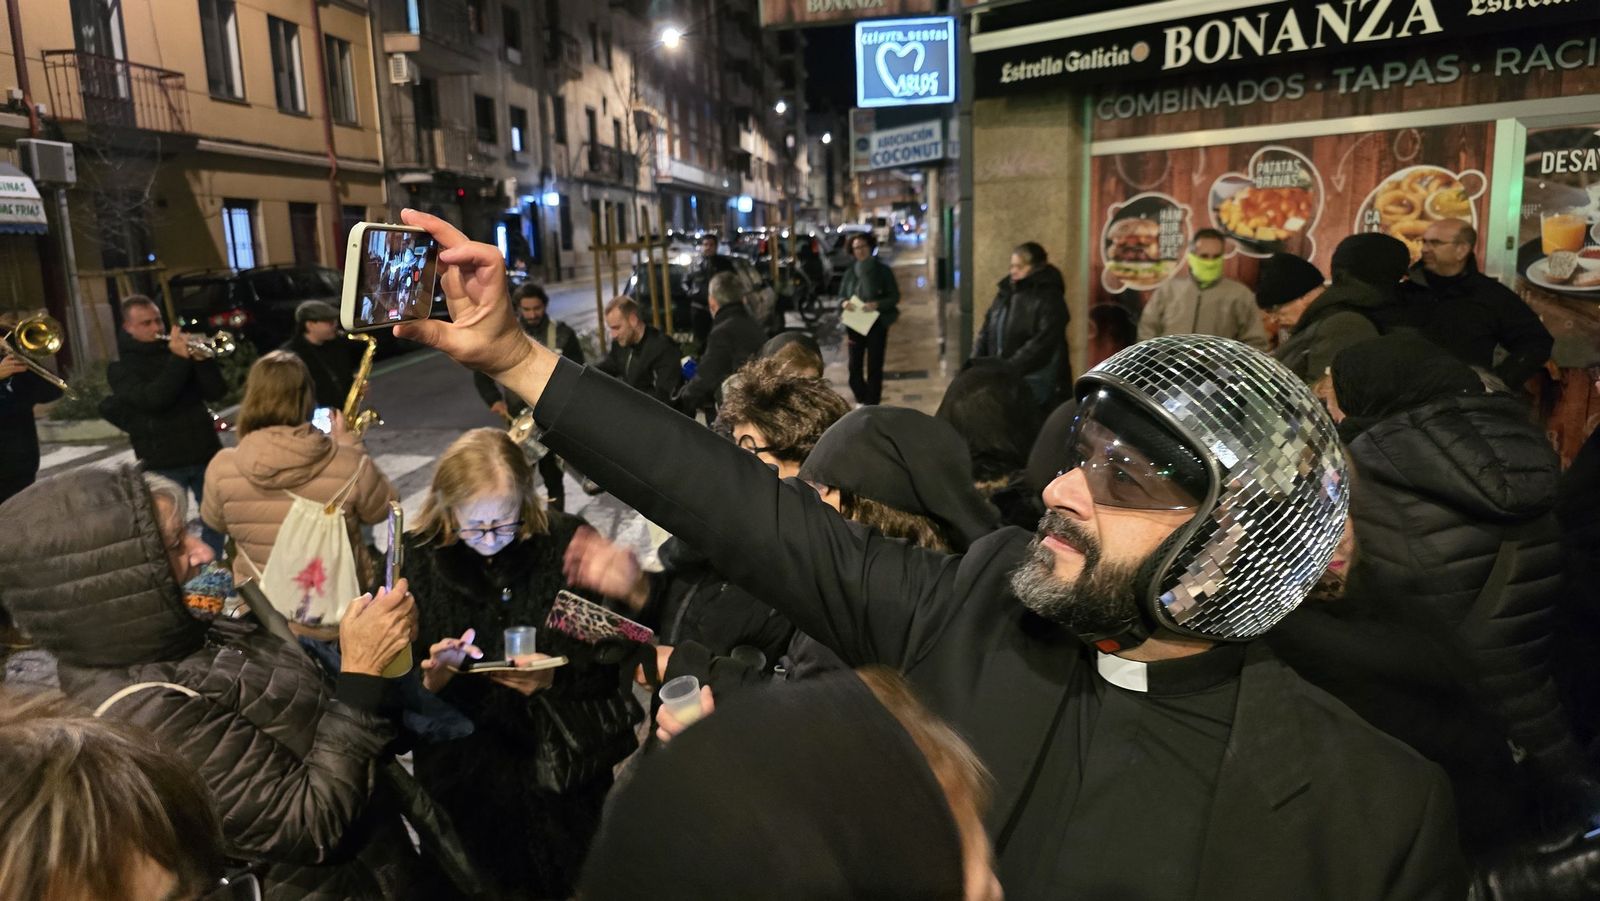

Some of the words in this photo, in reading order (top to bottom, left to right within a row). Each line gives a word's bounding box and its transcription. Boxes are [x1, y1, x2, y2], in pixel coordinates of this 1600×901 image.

[1161, 0, 1443, 70] BONANZA
[1000, 56, 1063, 83] Estrella
[1065, 45, 1130, 72] Galicia
[1097, 74, 1305, 121] COMBINADOS
[1333, 55, 1460, 95] TAPAS
[871, 141, 940, 165] COCONUT
[1256, 159, 1301, 174] PATATAS
[1256, 174, 1299, 188] BRAVAS
[1364, 209, 1380, 224] CA
